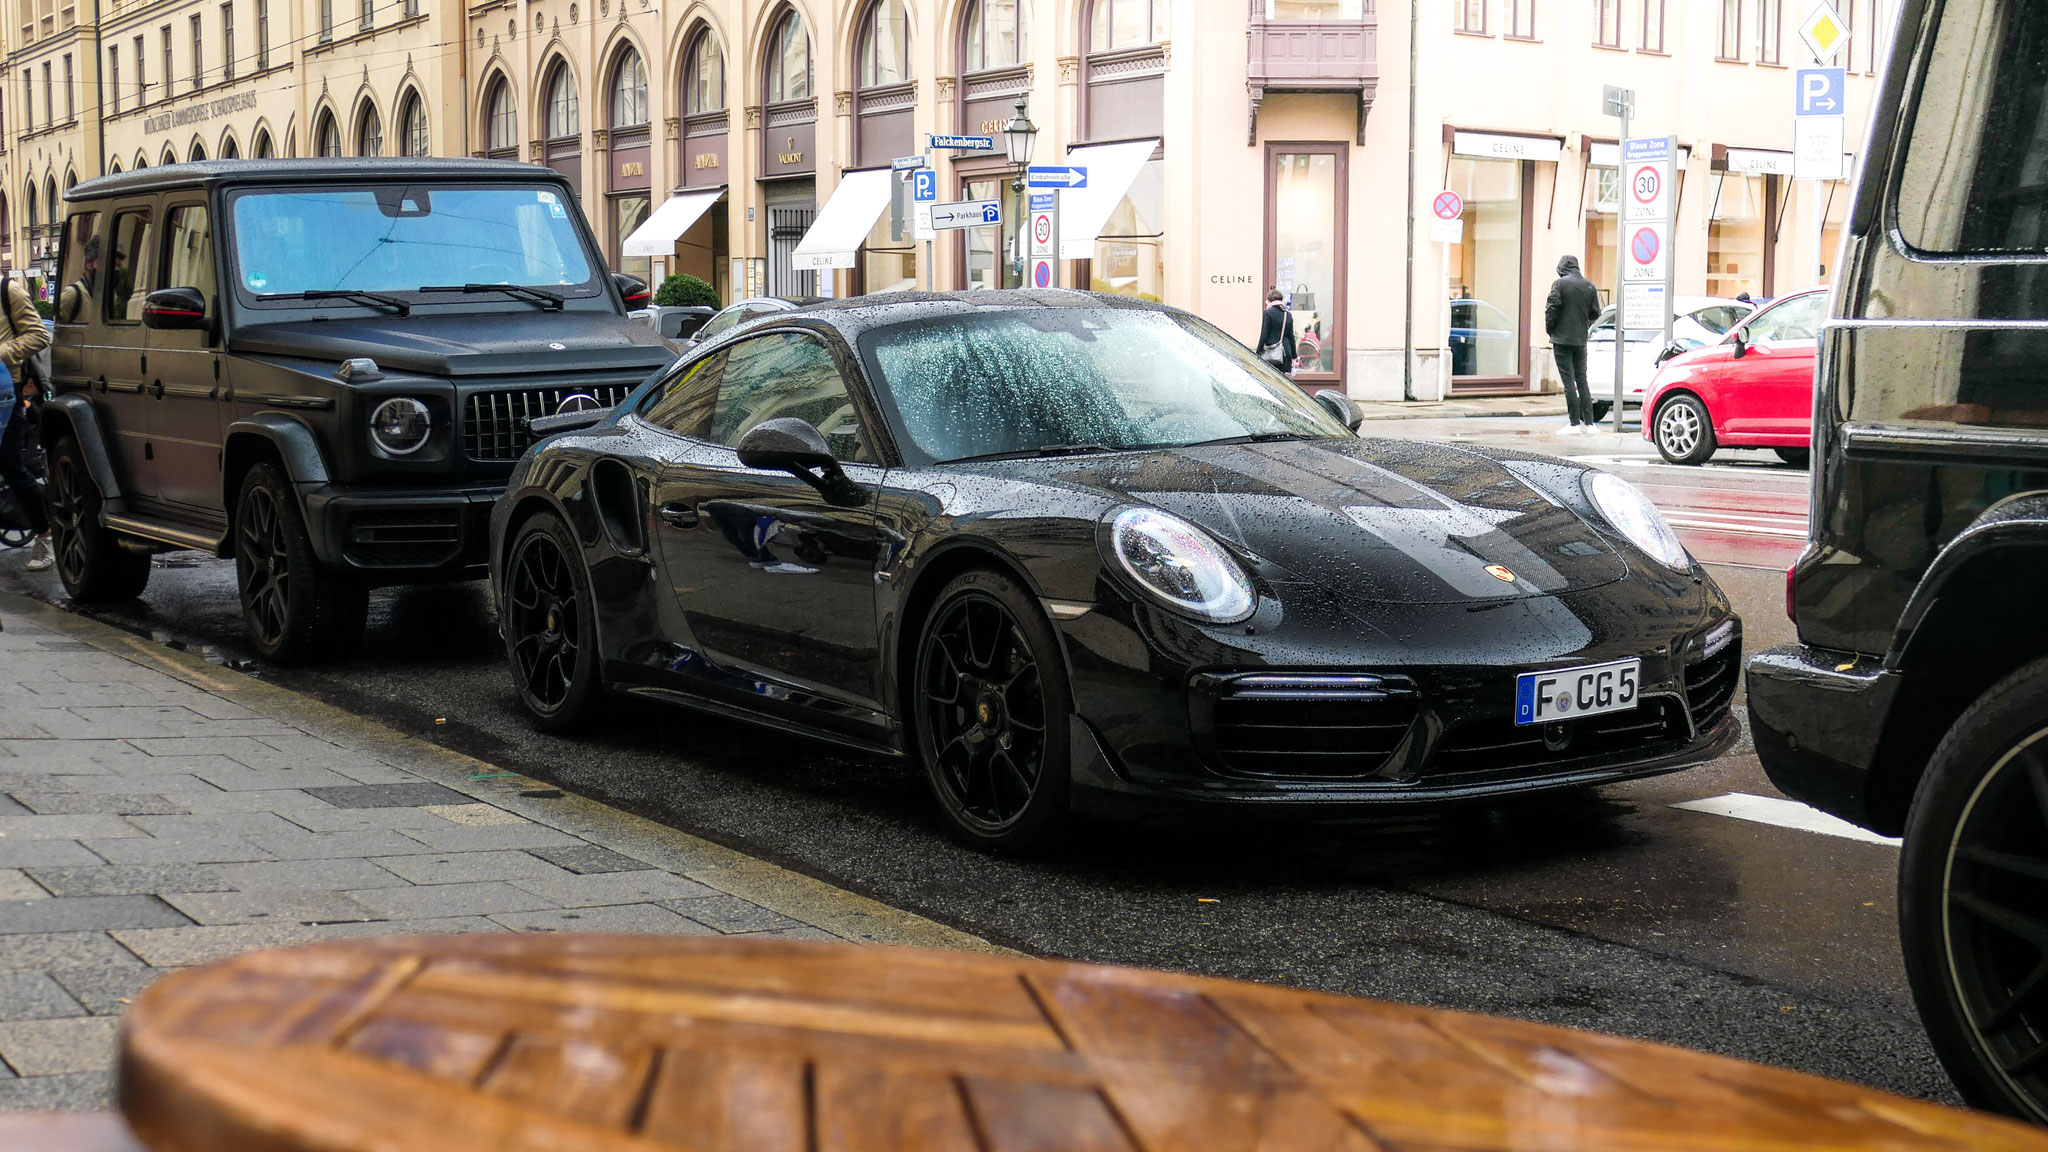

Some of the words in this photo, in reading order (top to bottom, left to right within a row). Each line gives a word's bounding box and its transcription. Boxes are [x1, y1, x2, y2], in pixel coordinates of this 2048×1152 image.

[1802, 73, 1830, 111] P
[981, 119, 1010, 134] CELIN
[934, 136, 991, 149] Falckenbergstr.
[1629, 141, 1648, 150] Blaue
[1649, 140, 1665, 149] Zone
[1493, 143, 1524, 154] CELINE
[779, 152, 802, 164] VALMONT
[1750, 159, 1777, 169] CELINE
[1031, 173, 1071, 181] Einbahnstraße
[917, 174, 930, 198] P
[1638, 176, 1655, 193] 30
[956, 211, 982, 220] Parkhaus
[1635, 206, 1656, 217] ZONE
[1038, 223, 1048, 236] 30
[1036, 245, 1048, 254] ZONE
[812, 256, 833, 266] CELINE
[1634, 267, 1656, 278] ZONE
[1210, 275, 1253, 284] CELINE
[1522, 704, 1529, 715] D
[1536, 678, 1557, 717] F
